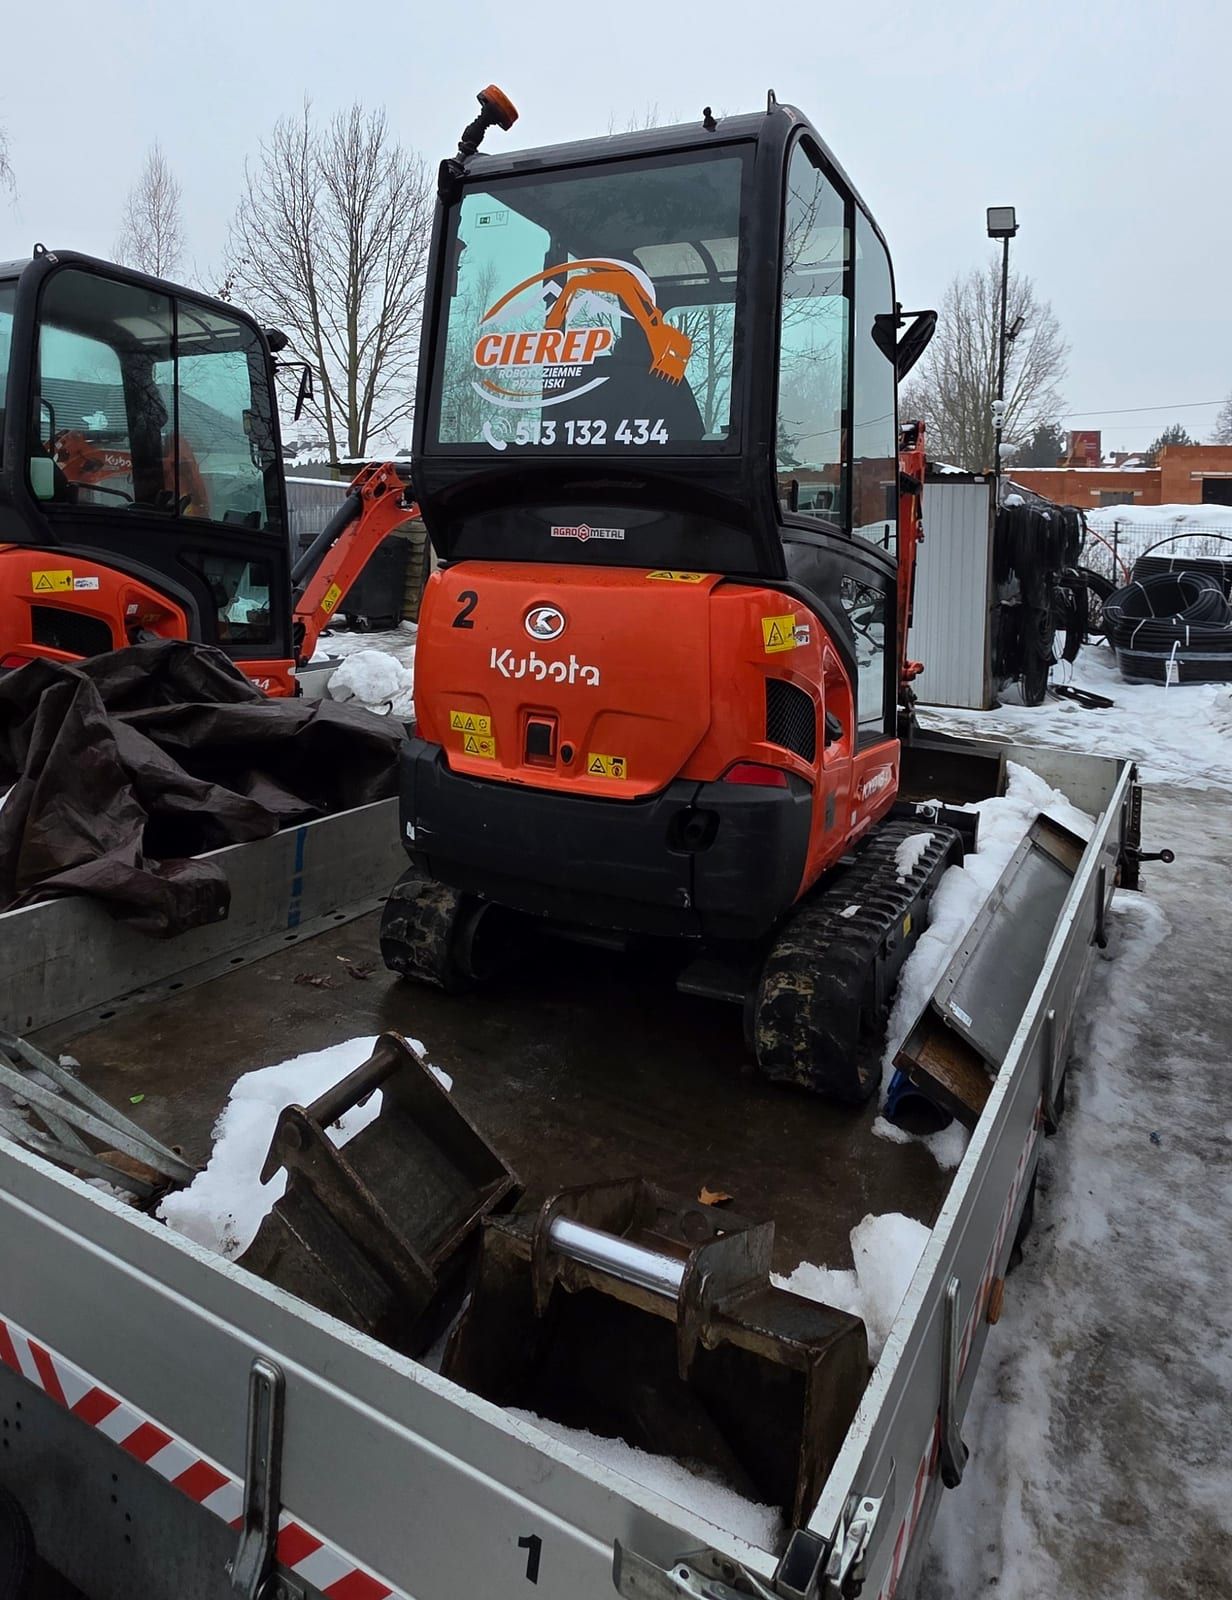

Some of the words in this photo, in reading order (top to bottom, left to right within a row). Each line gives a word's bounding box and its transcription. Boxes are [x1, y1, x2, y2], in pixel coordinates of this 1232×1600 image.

[474, 329, 612, 367] CIEREP
[543, 366, 583, 378] ZIEMNE
[515, 420, 557, 446] 513
[564, 419, 608, 446] 132
[614, 418, 669, 446] 434
[105, 454, 132, 468] Kubo
[553, 527, 578, 537] AGRO
[590, 529, 623, 539] METAL
[453, 591, 478, 628] 2
[490, 647, 600, 687] Kubota
[518, 1534, 542, 1584] 1
